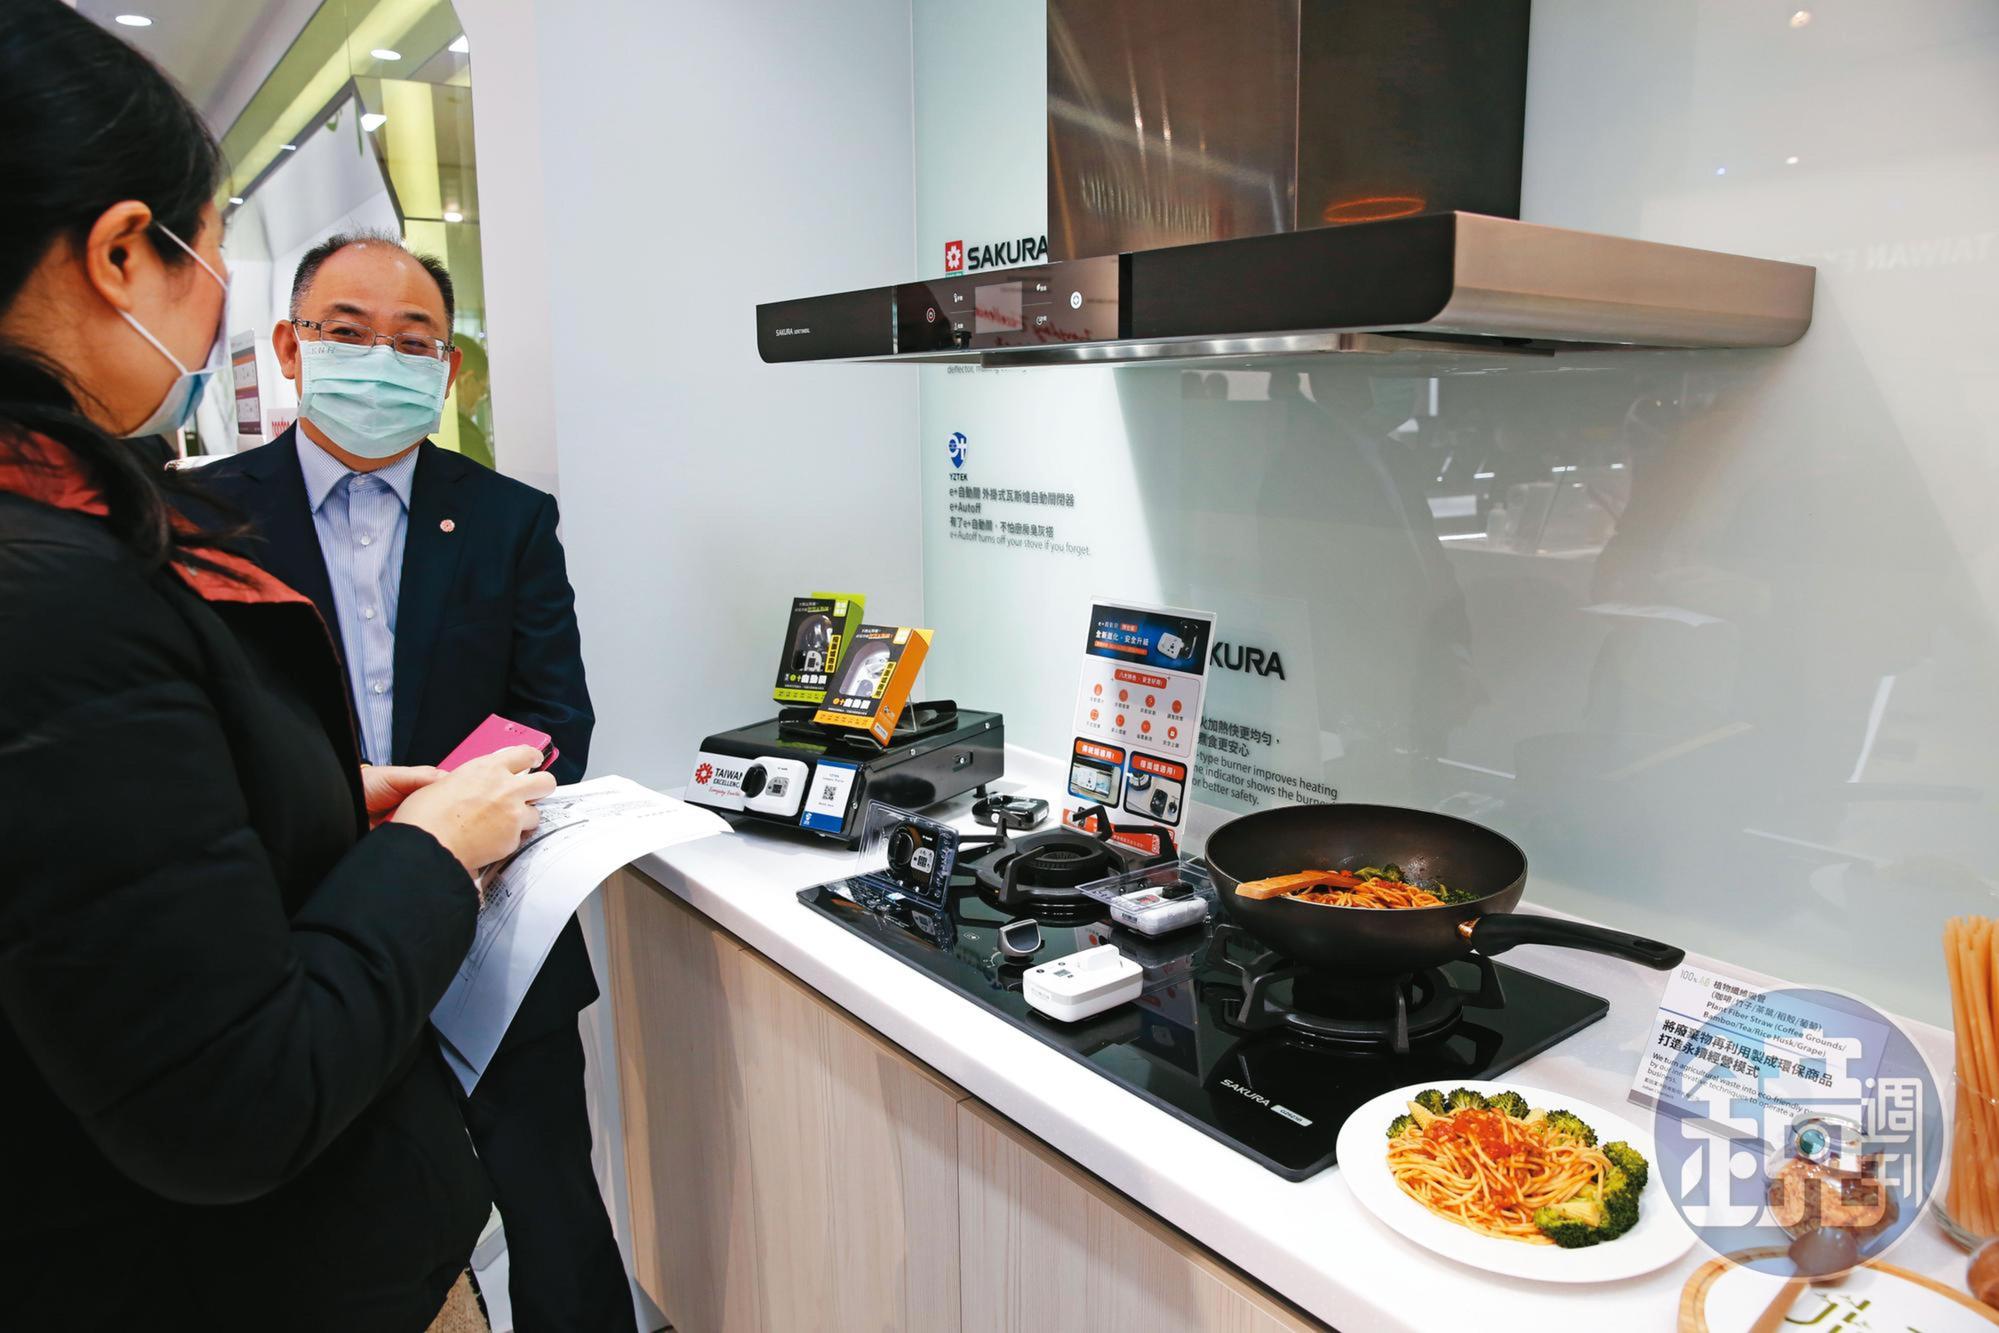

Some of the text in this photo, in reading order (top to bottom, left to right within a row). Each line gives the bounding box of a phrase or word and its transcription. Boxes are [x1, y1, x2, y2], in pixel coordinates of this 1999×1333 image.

[967, 235, 1048, 270] SAKURA
[949, 473, 968, 481] YZTEK
[949, 502, 981, 513] e+Autoff
[997, 536, 1006, 545] off
[1007, 538, 1023, 548] your
[1024, 539, 1043, 550] stove
[1050, 543, 1065, 553] you
[1210, 641, 1286, 681] KURA
[713, 778, 741, 788] EXCELLENC
[1192, 777, 1260, 805] or better safety.
[1197, 751, 1338, 801] -type burner improves heating
[1205, 768, 1245, 786] indicator
[1246, 778, 1276, 795] shows
[1278, 786, 1294, 800] the
[1296, 790, 1328, 805] burn
[1703, 1011, 1826, 1058] Bamboo/Tea/Rice Husk/Grape)
[1706, 1001, 1847, 1052] Plant Fiber Straw (Coffee Grounds/
[1658, 1033, 1760, 1079] 打造永續經營模式
[1662, 1019, 1833, 1088] 將廢棄物再利用製成環保商品
[1220, 1079, 1270, 1106] SAKURA
[1650, 1060, 1658, 1069] by
[1749, 1096, 1758, 1104] to
[1759, 1099, 1789, 1115] operate
[1652, 1052, 1664, 1062] We
[1665, 1057, 1679, 1067] turn
[1680, 1063, 1720, 1080] agricultural
[1720, 1075, 1741, 1089] waste
[1742, 1083, 1757, 1095] into
[1758, 1091, 1803, 1114] eco-friendly
